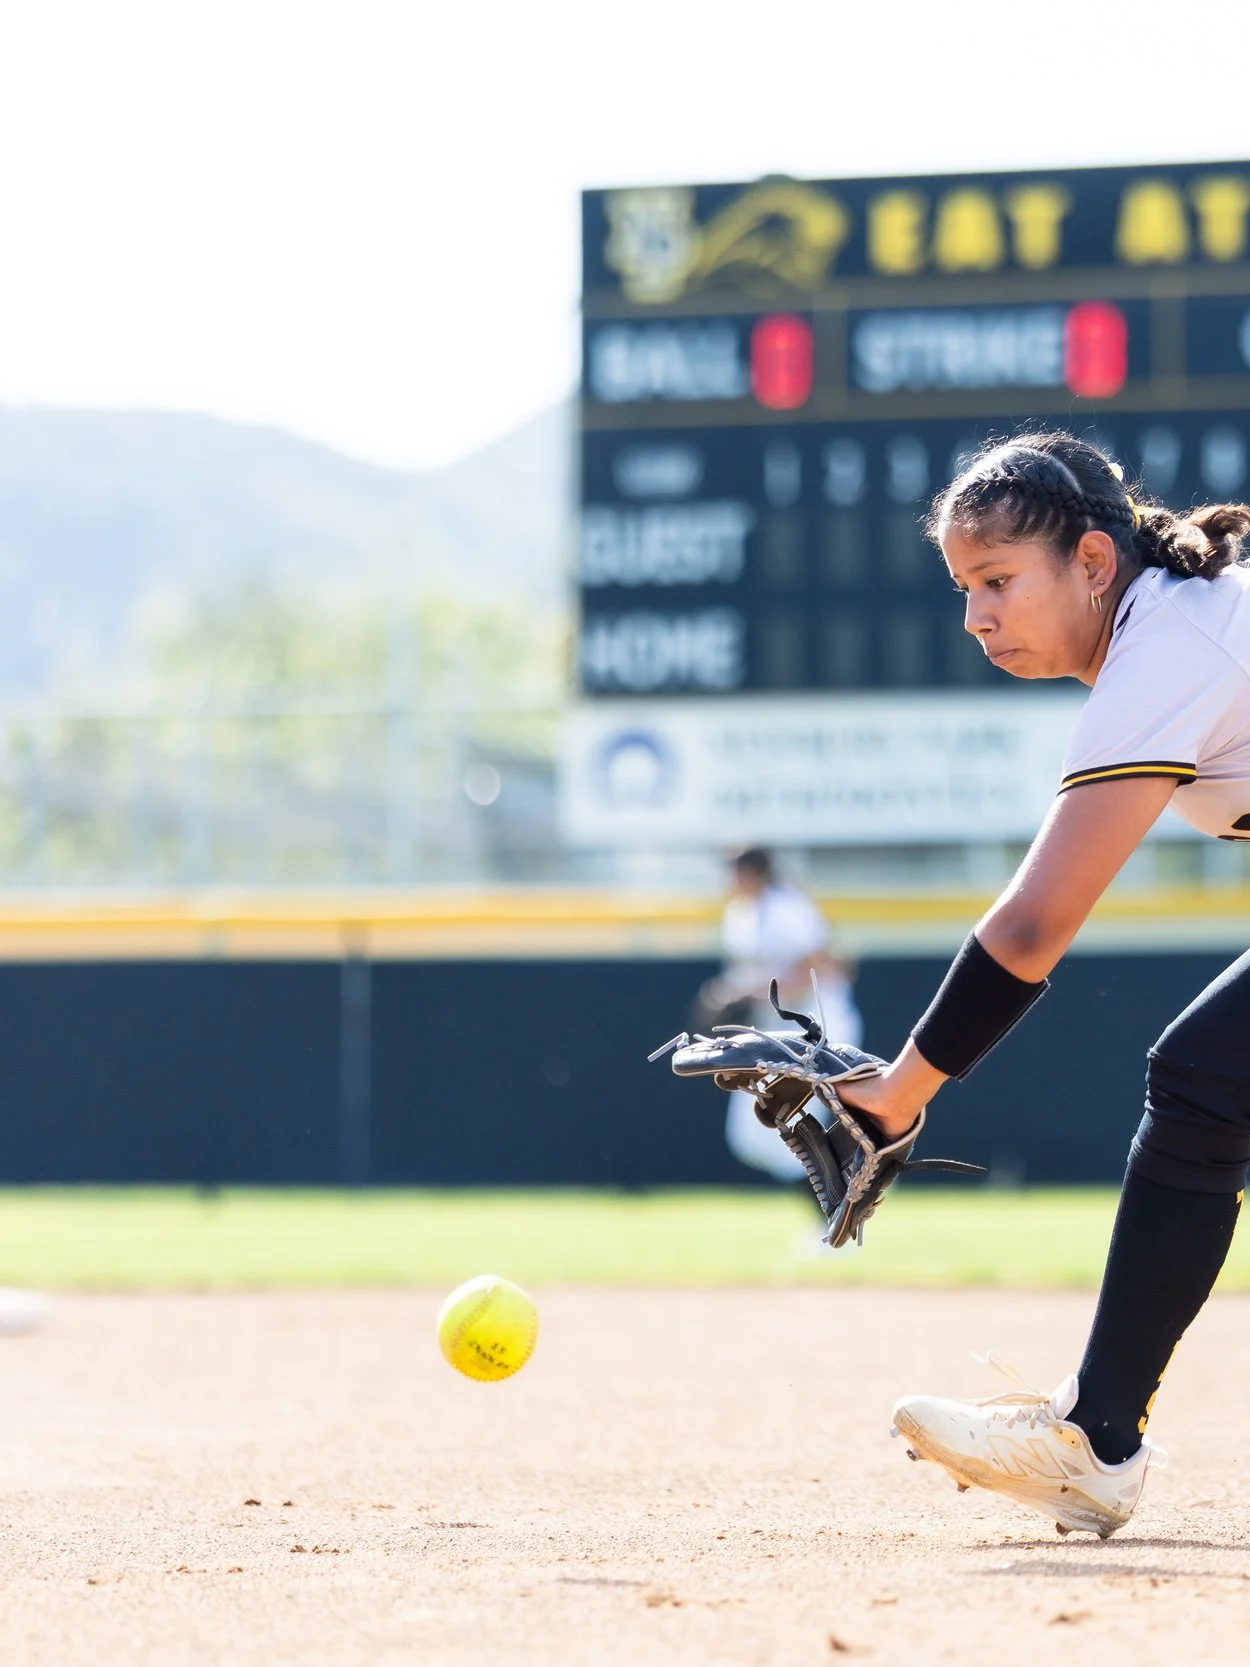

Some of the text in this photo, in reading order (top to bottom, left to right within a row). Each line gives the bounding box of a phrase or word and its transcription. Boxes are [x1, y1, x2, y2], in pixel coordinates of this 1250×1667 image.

[866, 187, 1067, 276] EAT
[591, 318, 746, 402] BALL
[852, 306, 1064, 394] STRIKE
[580, 502, 753, 587] GUEST
[580, 606, 746, 691] HOME
